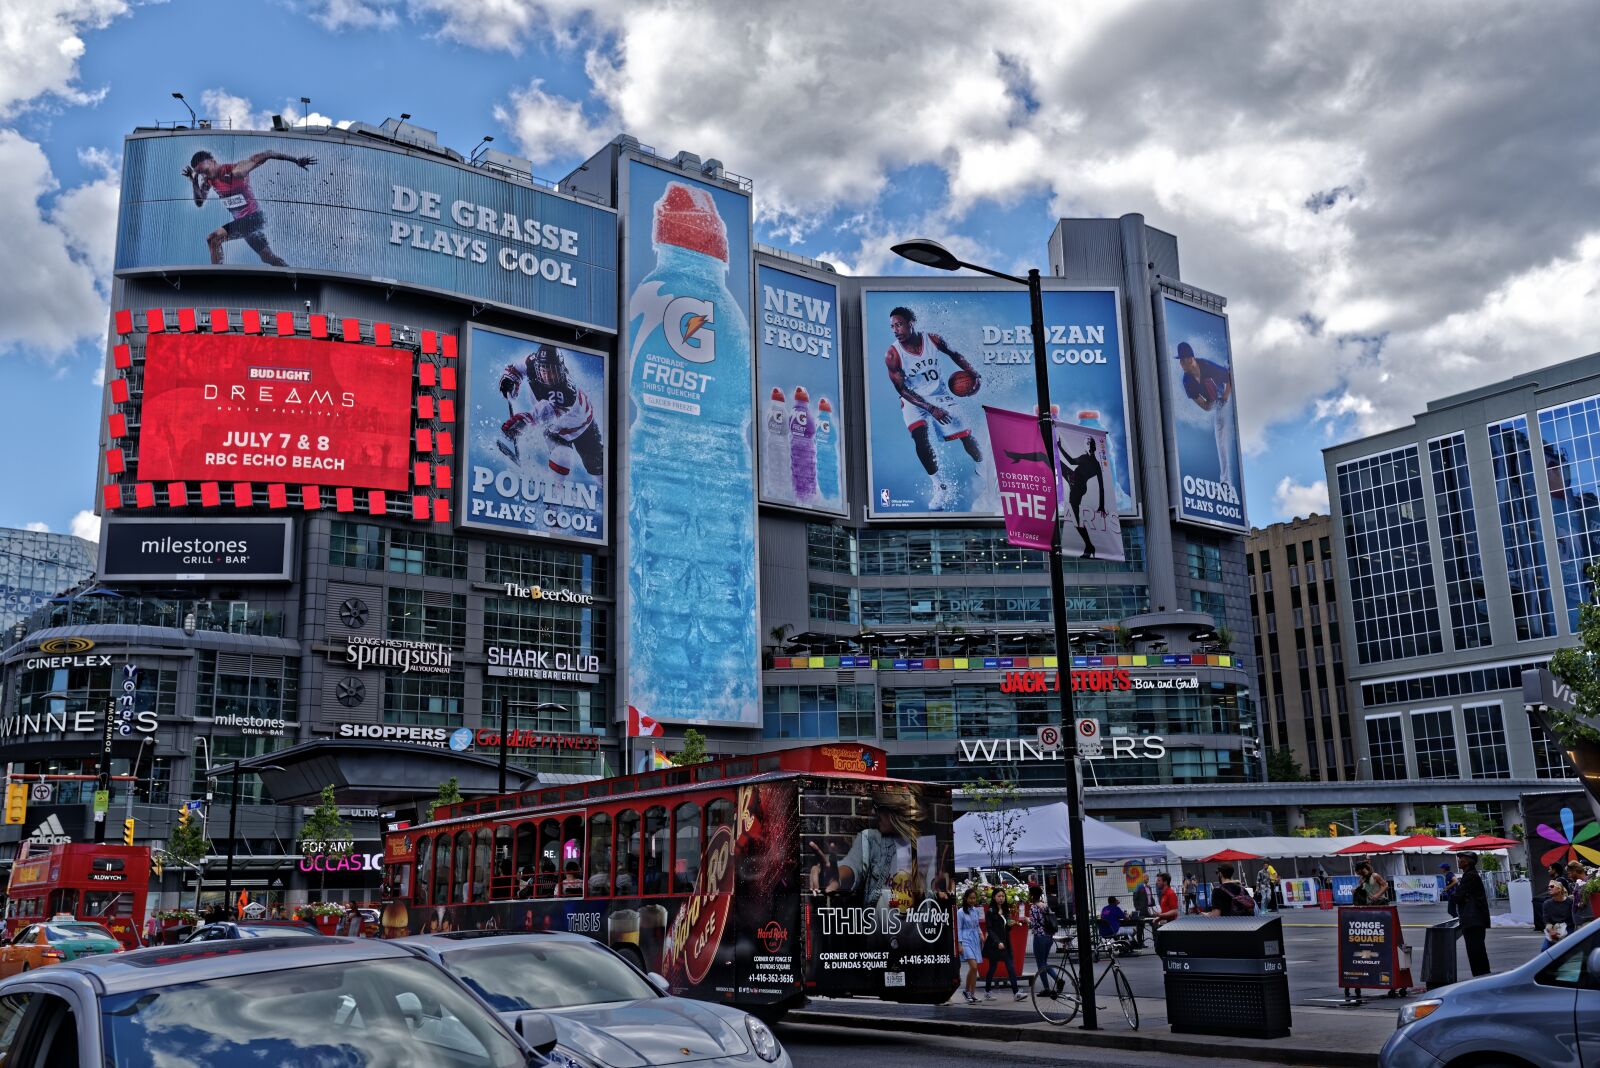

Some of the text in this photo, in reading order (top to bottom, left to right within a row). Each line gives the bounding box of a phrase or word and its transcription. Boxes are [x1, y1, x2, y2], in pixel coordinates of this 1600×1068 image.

[391, 185, 579, 257] DE GRASSE
[389, 219, 578, 287] PLAYS COOL
[763, 284, 832, 325] NEW
[764, 312, 832, 340] GATORADE
[764, 325, 832, 359] FROST
[1052, 349, 1107, 364] COOL
[250, 368, 310, 381] BUD LIGHT
[642, 362, 712, 393] FROST
[920, 369, 939, 382] 10
[204, 384, 355, 408] DREAMS
[642, 381, 665, 394] THIRST
[548, 391, 564, 404] 29
[272, 408, 340, 417] FESTIVAL
[222, 431, 330, 451] JULY 7 & 8
[205, 452, 345, 471] RBC ECHO BEACH
[1000, 472, 1047, 484] TORONTO'S
[1002, 480, 1040, 491] DISTRICT
[472, 466, 599, 511] POULIN
[1183, 475, 1240, 505] OSUNA
[1000, 492, 1047, 520] THE
[1185, 497, 1241, 519] PLAYS COOL
[472, 498, 598, 533] PLAYS COOL
[141, 536, 248, 553] milestones
[182, 556, 247, 564] GRILL BAR
[348, 635, 437, 651] LOUNGE RESTAURANT
[26, 655, 112, 670] CINEPLEX
[488, 646, 599, 673] SHARK CLUB
[508, 668, 583, 681] SPORTS BAR GRILL
[1000, 671, 1048, 693] JACK
[1134, 678, 1154, 690] Bar
[1157, 678, 1173, 689] and
[1175, 678, 1200, 690] Grill
[0, 711, 158, 738] WINNES
[104, 700, 116, 753] DOWNTOWN
[214, 713, 286, 728] milestones
[339, 724, 447, 741] SHOPPERS
[541, 735, 599, 750] FITNESS
[960, 735, 1166, 762] WINRS
[351, 808, 379, 817] ULTRA
[28, 834, 72, 845] adidas
[567, 912, 601, 932] THIS IS
[817, 907, 902, 935] THIS IS
[905, 907, 950, 926] Hard Rock
[1349, 921, 1385, 929] YONGE-
[694, 911, 716, 959] CAFE
[1349, 928, 1385, 936] DUNDAS
[1349, 935, 1385, 943] SQUARE
[820, 952, 848, 960] CORNER
[849, 952, 859, 960] OF
[859, 952, 882, 960] YONGE
[899, 954, 951, 965] +1-416-362-3636
[824, 961, 888, 971] & DUNDAS SQUARE
